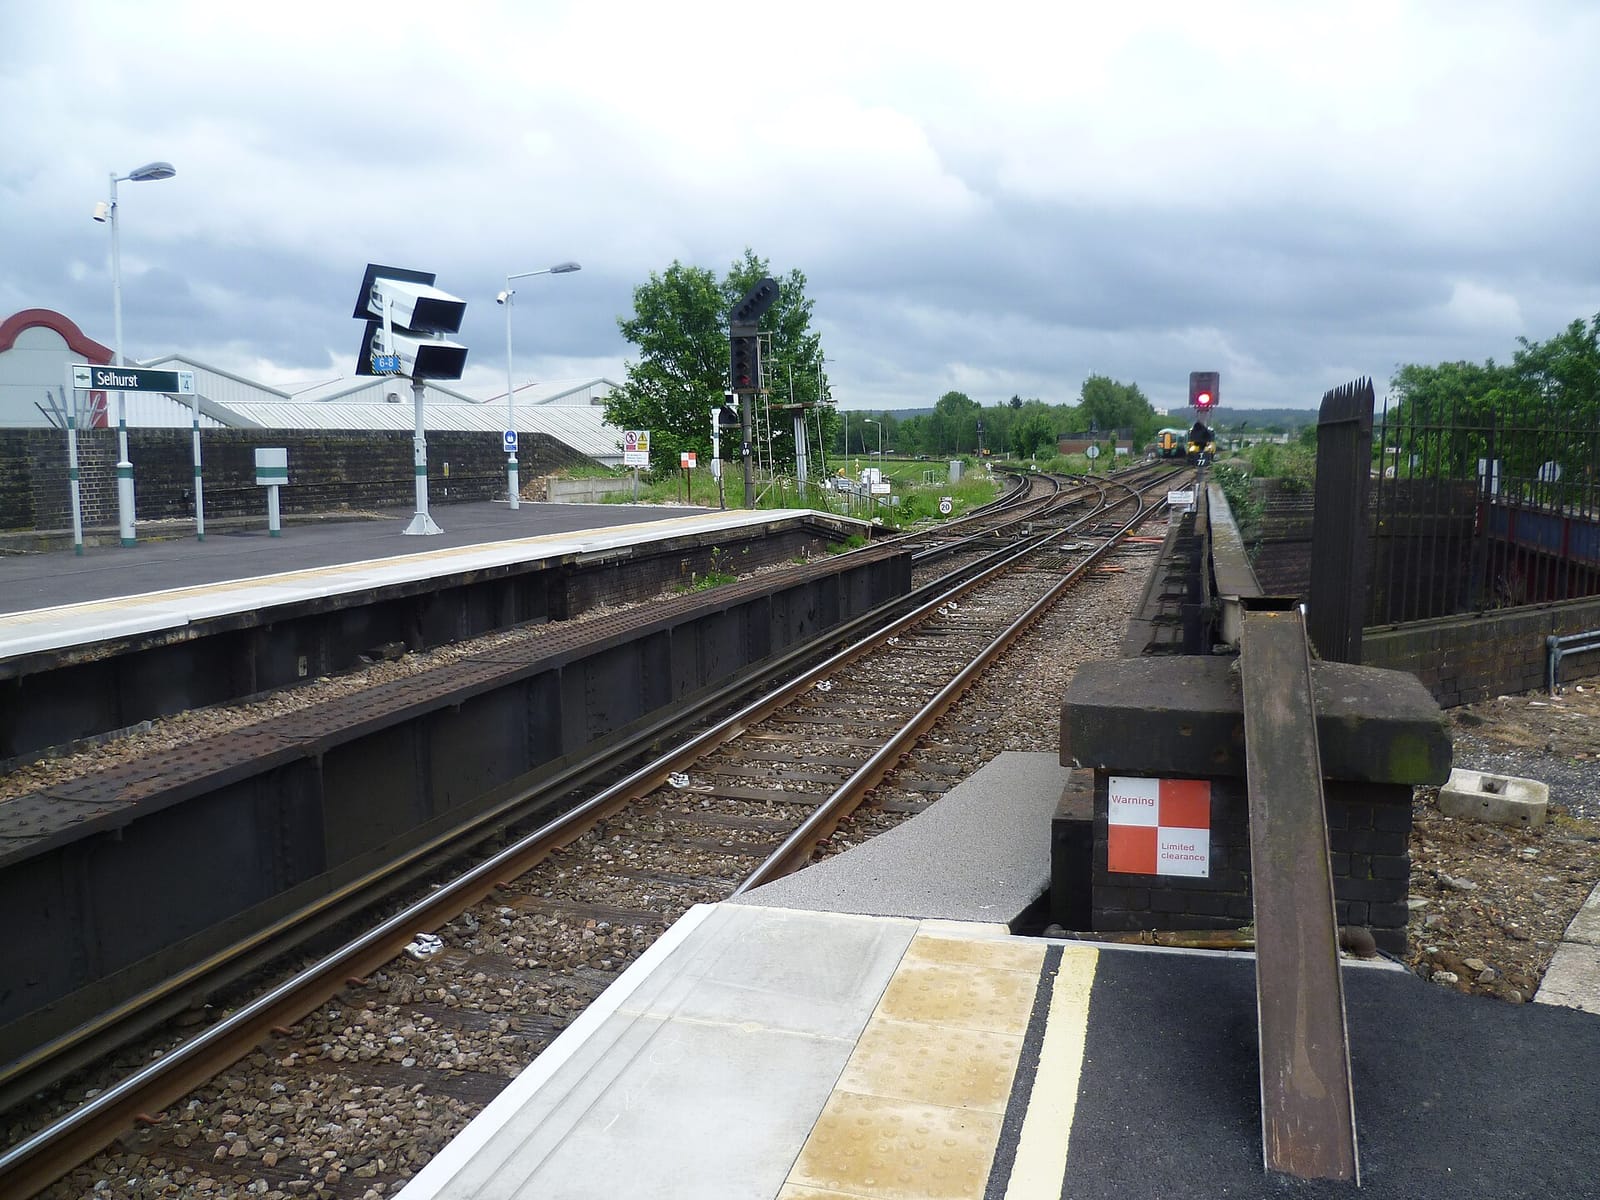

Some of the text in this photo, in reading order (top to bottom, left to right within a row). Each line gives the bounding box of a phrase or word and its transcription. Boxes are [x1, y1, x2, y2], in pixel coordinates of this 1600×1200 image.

[380, 357, 394, 367] 6-8
[97, 371, 138, 387] Selhurst
[184, 380, 190, 391] 4
[1112, 795, 1154, 807] Warning
[1161, 843, 1195, 852] Limited
[1161, 852, 1206, 862] clearance
